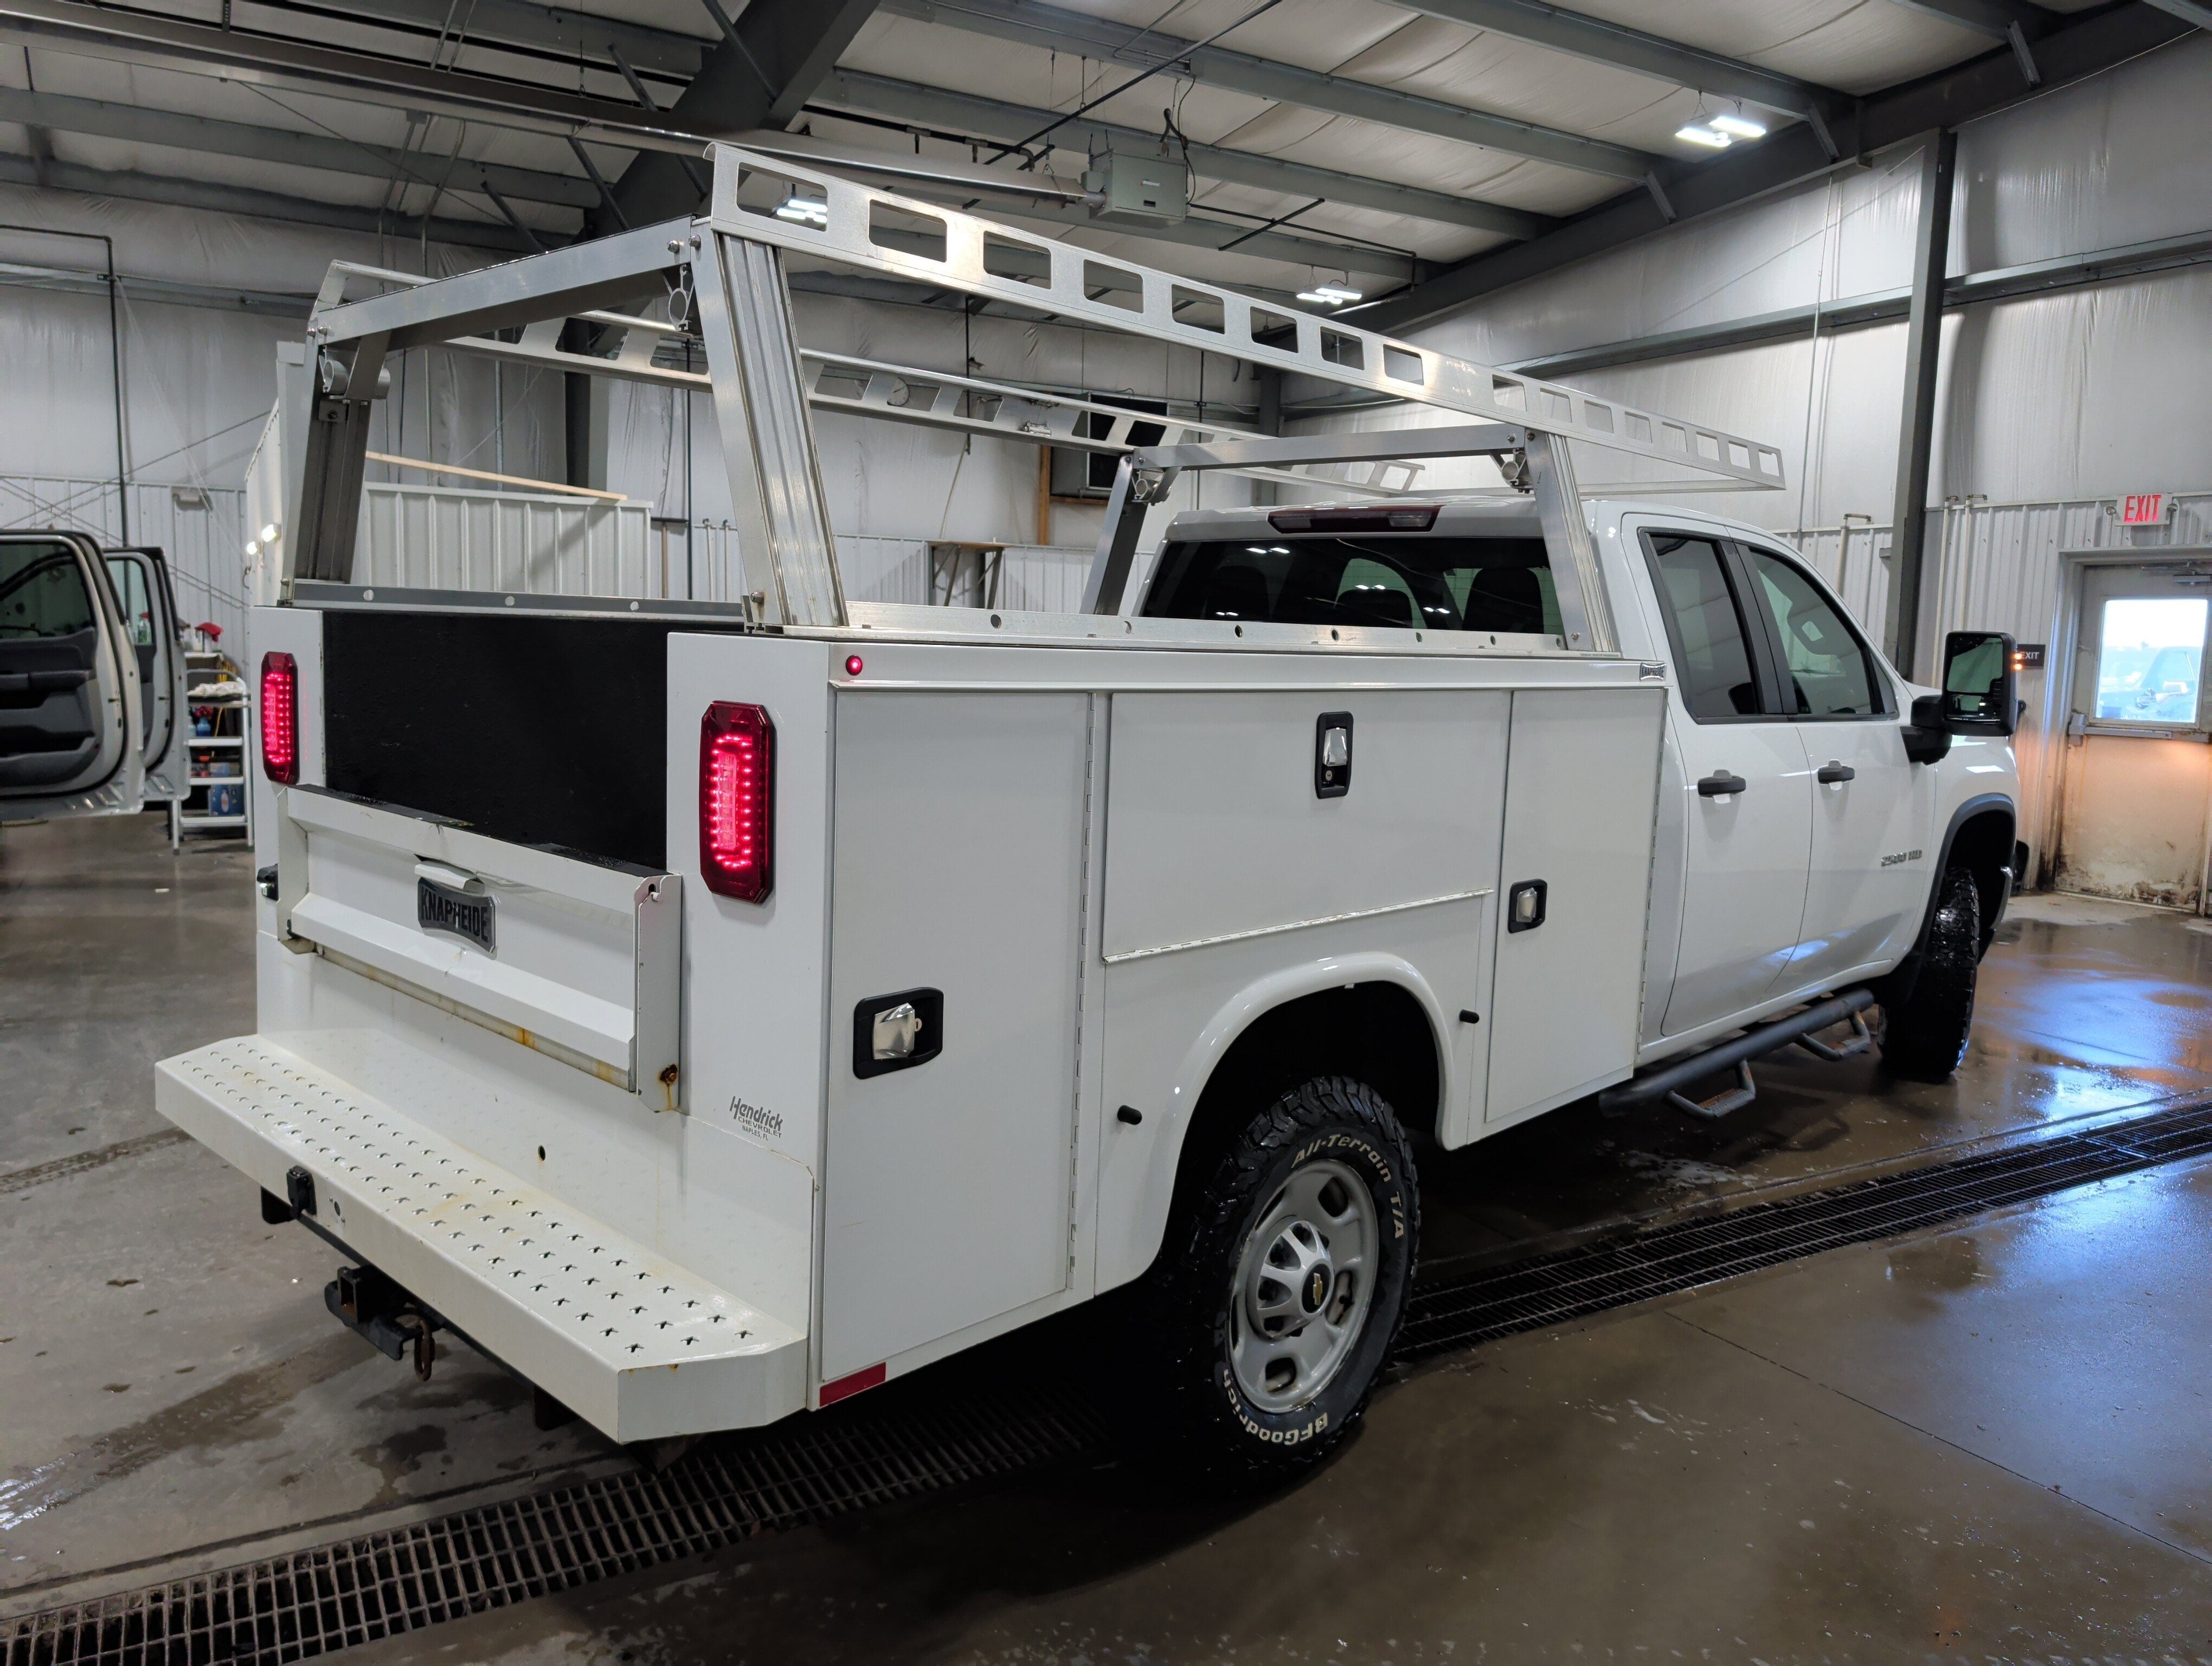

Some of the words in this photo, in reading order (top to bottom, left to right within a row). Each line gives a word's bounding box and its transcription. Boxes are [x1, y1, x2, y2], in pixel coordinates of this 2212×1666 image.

[2124, 494, 2162, 522] EXIT
[421, 886, 488, 943] KNAPHEIDE
[729, 1095, 783, 1131] Hendrick
[738, 1116, 782, 1138] CHEVROLET
[742, 1125, 762, 1139] NAPLES,
[763, 1133, 769, 1141] FL
[1291, 1134, 1391, 1182] All-Terrain
[1390, 1191, 1404, 1239] T/A
[1224, 1369, 1328, 1445] BFGoodrich
